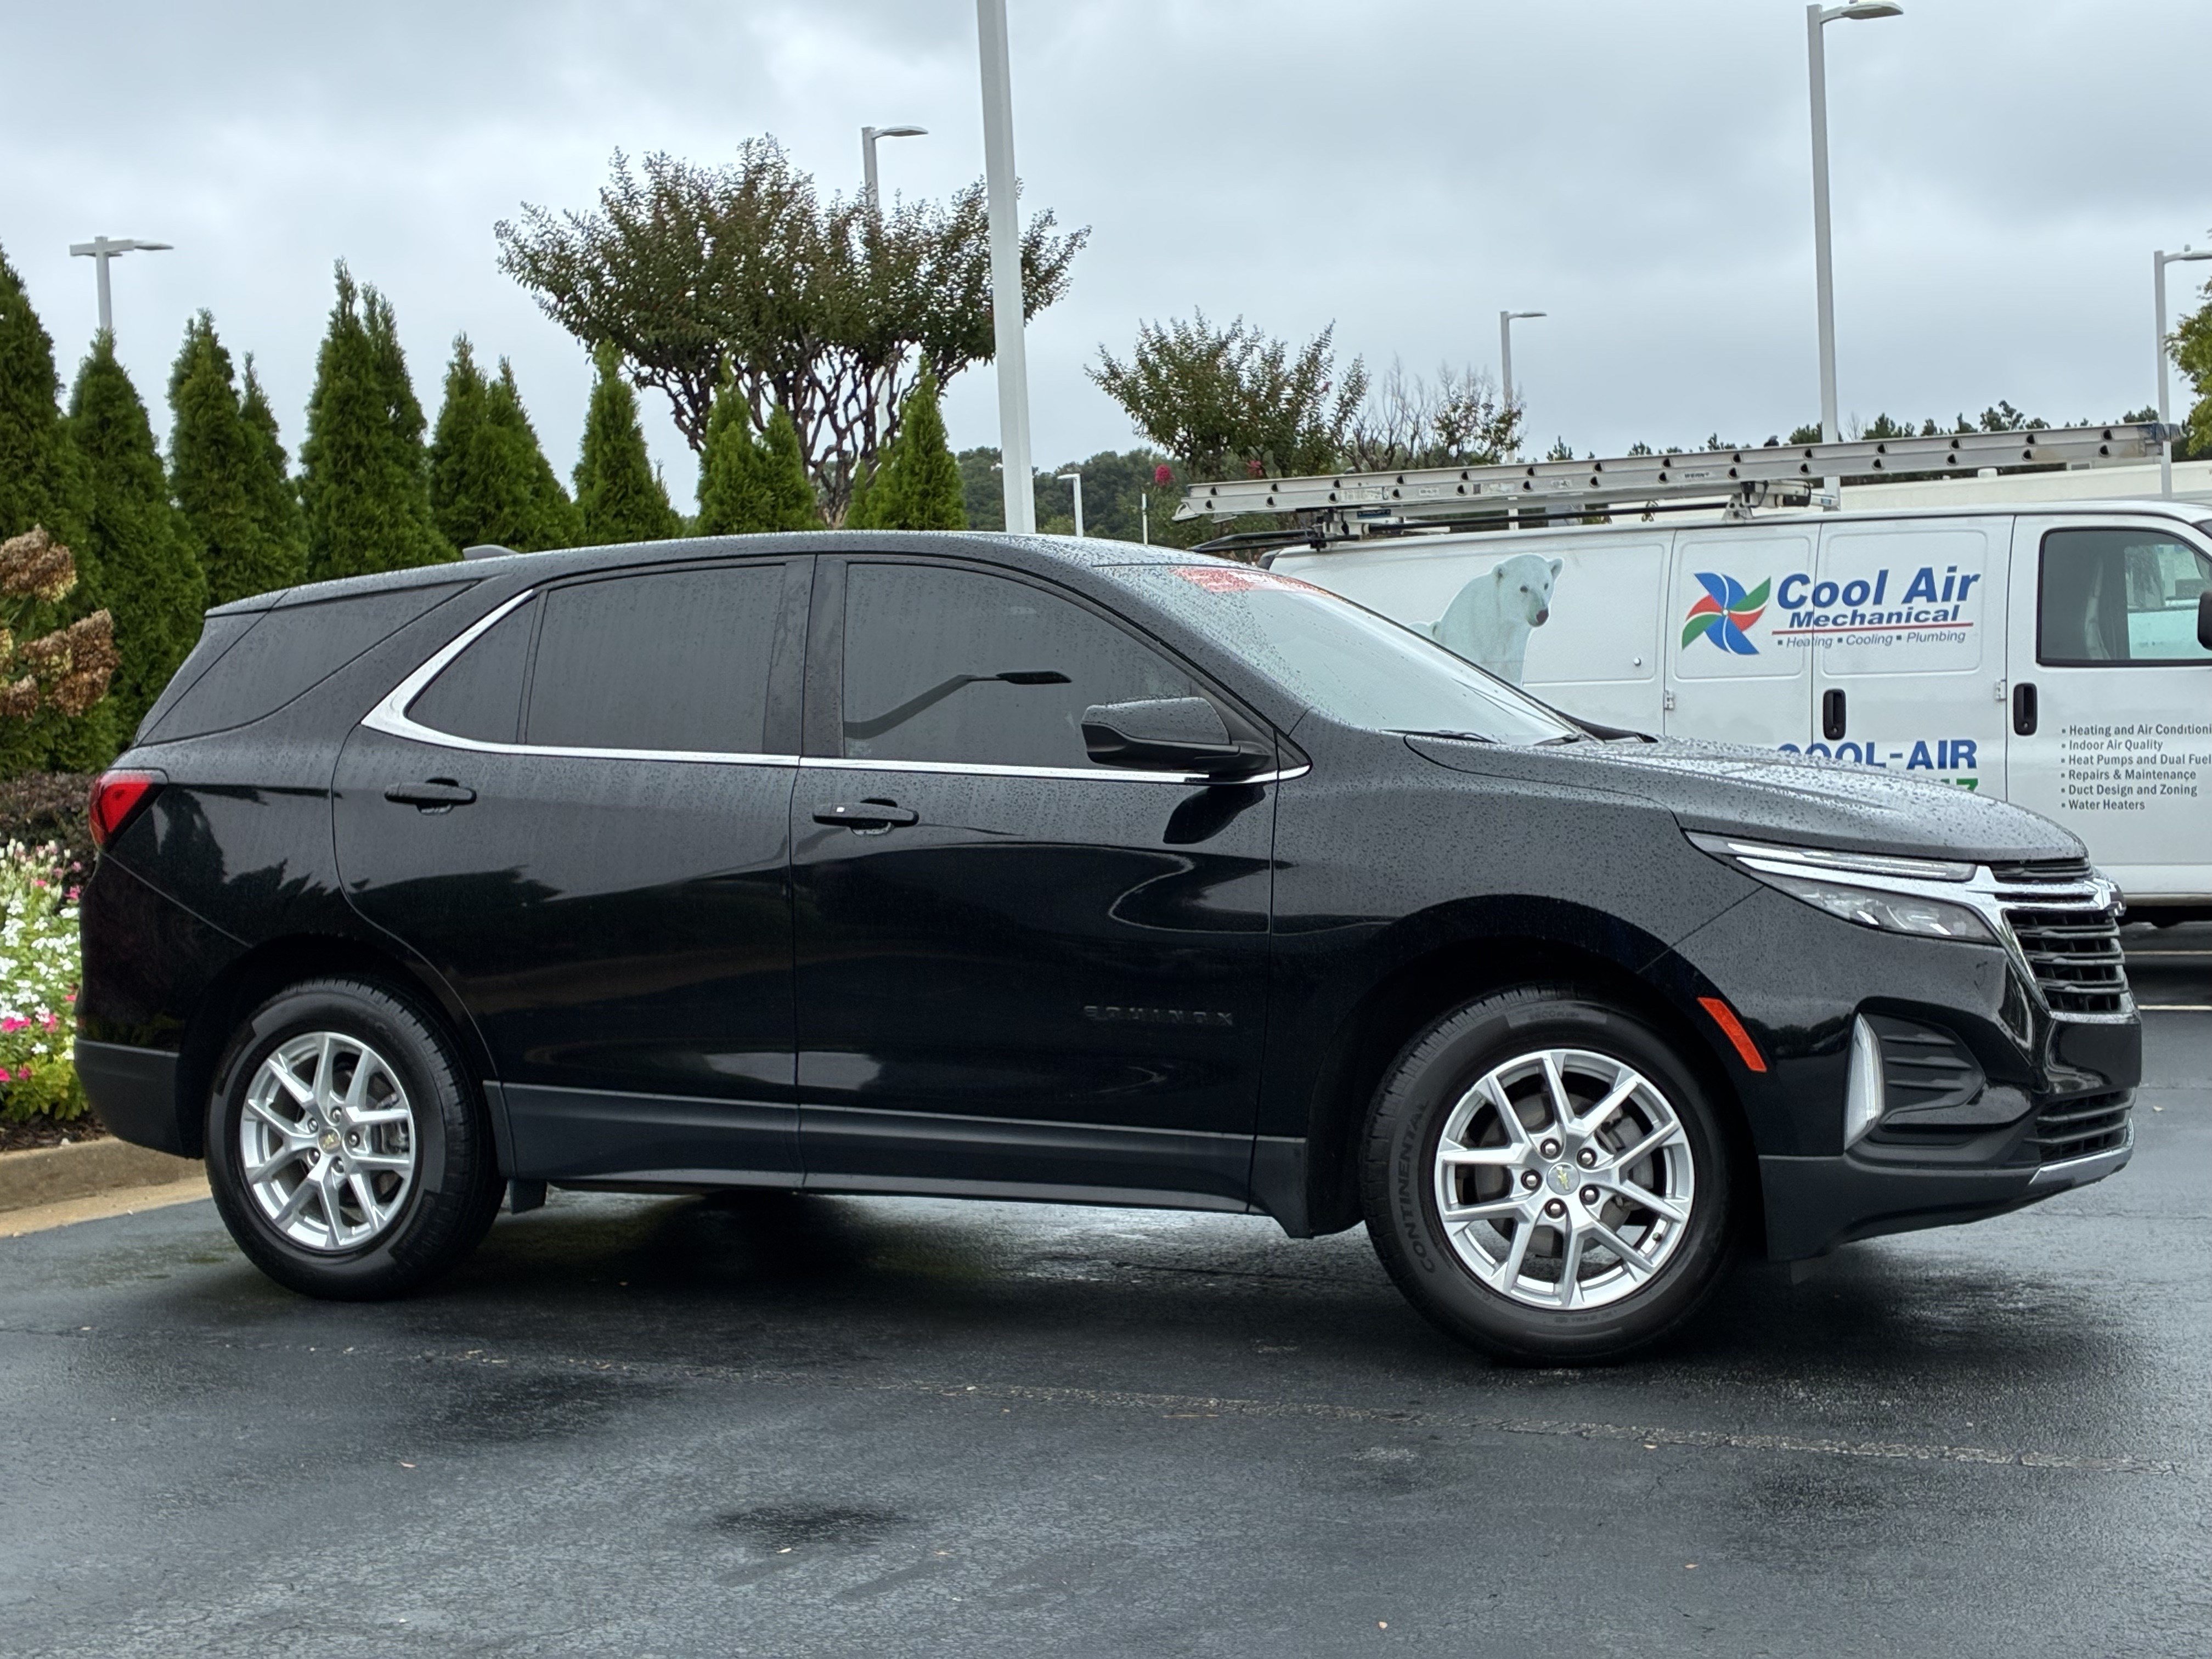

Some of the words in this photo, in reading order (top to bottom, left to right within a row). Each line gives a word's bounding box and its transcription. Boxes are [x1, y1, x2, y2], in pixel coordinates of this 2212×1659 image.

[1777, 569, 1889, 610] Cool
[1901, 566, 1982, 604] Air
[1789, 605, 1960, 629] Mechanical
[1846, 634, 1893, 647] Cooling
[1906, 631, 1966, 644] Plumbing
[2069, 725, 2112, 737] Heating
[2114, 724, 2134, 735] and
[2137, 724, 2153, 735] Air
[2069, 740, 2104, 751] Indoor
[2107, 740, 2123, 750] Air
[2125, 739, 2163, 752] Quality
[2069, 755, 2094, 765] Heat
[2097, 755, 2134, 766] Pumps
[2136, 754, 2157, 765] and
[2160, 753, 2185, 765] Dual
[2189, 753, 2211, 765] Fuel
[2069, 769, 2110, 781] Repairs
[2113, 770, 2121, 780] &
[2125, 769, 2197, 781] Maintenance
[2069, 785, 2094, 795] Duct
[2097, 785, 2133, 796] Design
[2136, 784, 2157, 795] and
[2160, 783, 2197, 797] Zoning
[2069, 799, 2101, 810] Water
[2103, 799, 2145, 810] Heaters
[1398, 1101, 1434, 1273] CONTINENTAL
